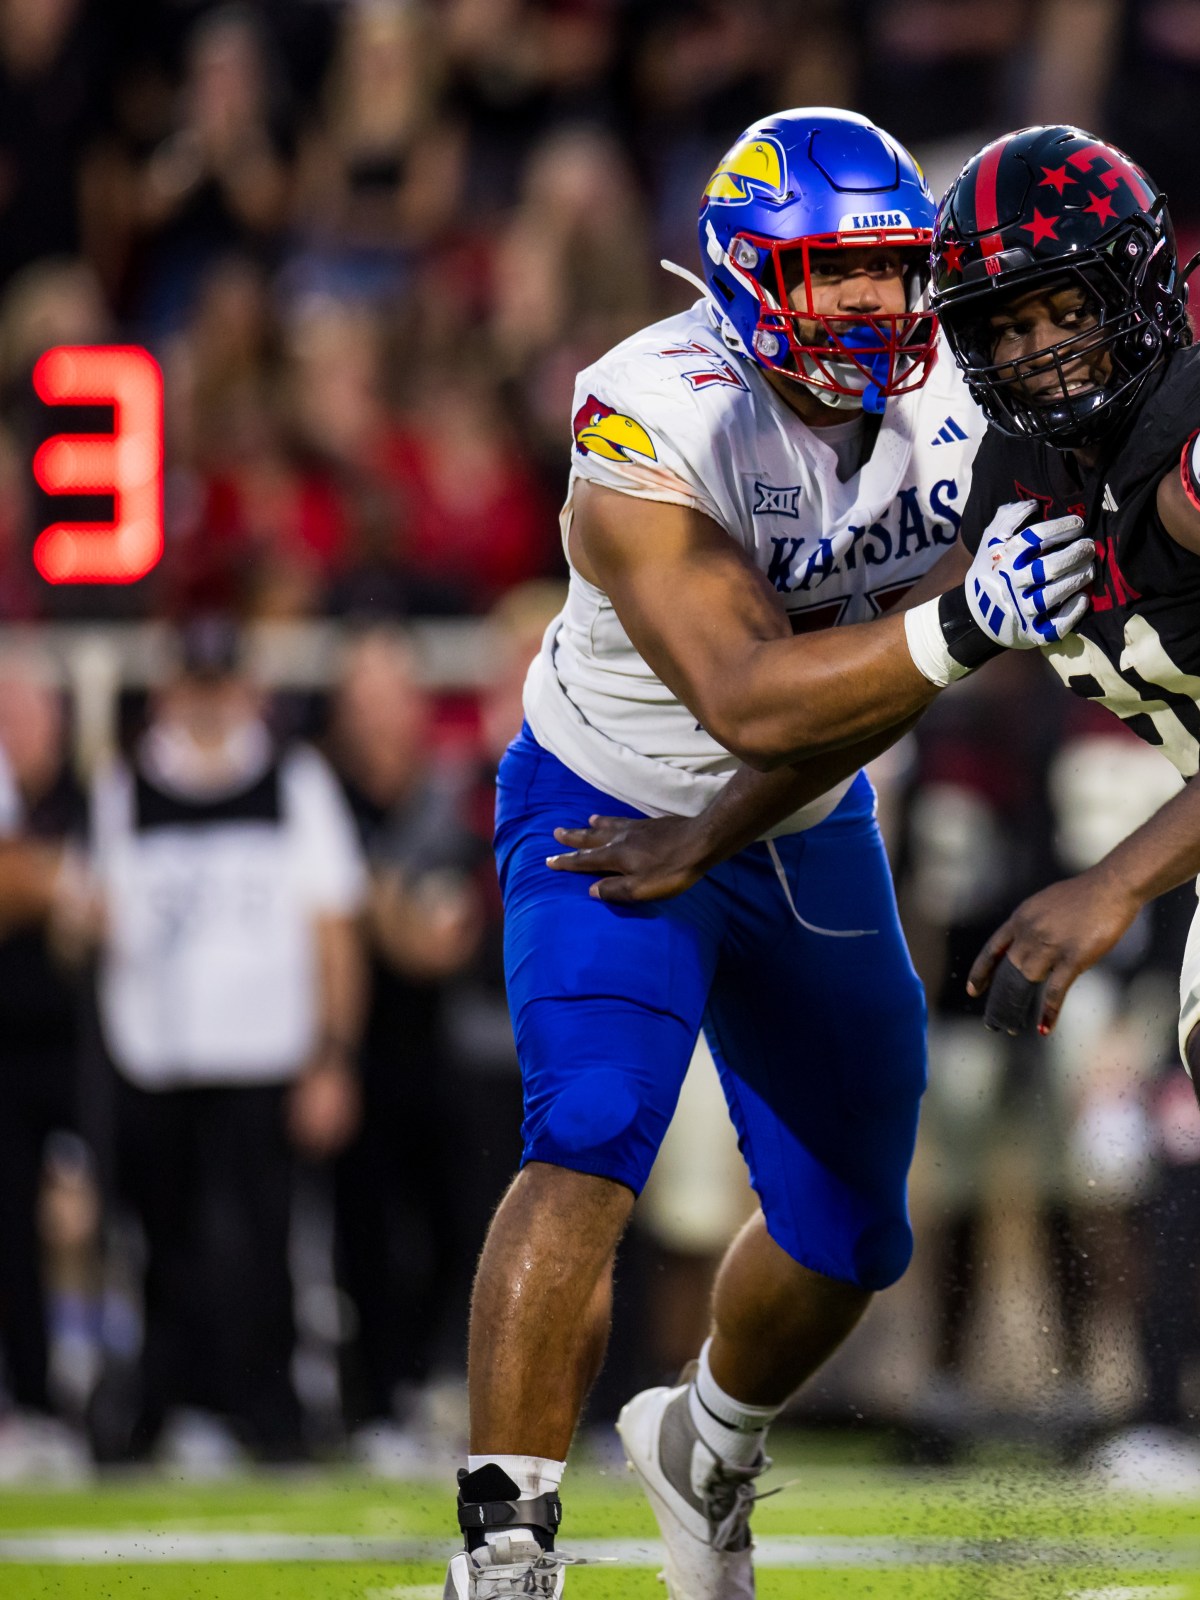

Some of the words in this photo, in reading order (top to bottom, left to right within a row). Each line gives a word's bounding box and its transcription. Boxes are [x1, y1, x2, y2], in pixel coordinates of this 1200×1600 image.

[852, 213, 902, 229] KANSAS
[33, 345, 164, 585] 3
[753, 481, 801, 519] XII
